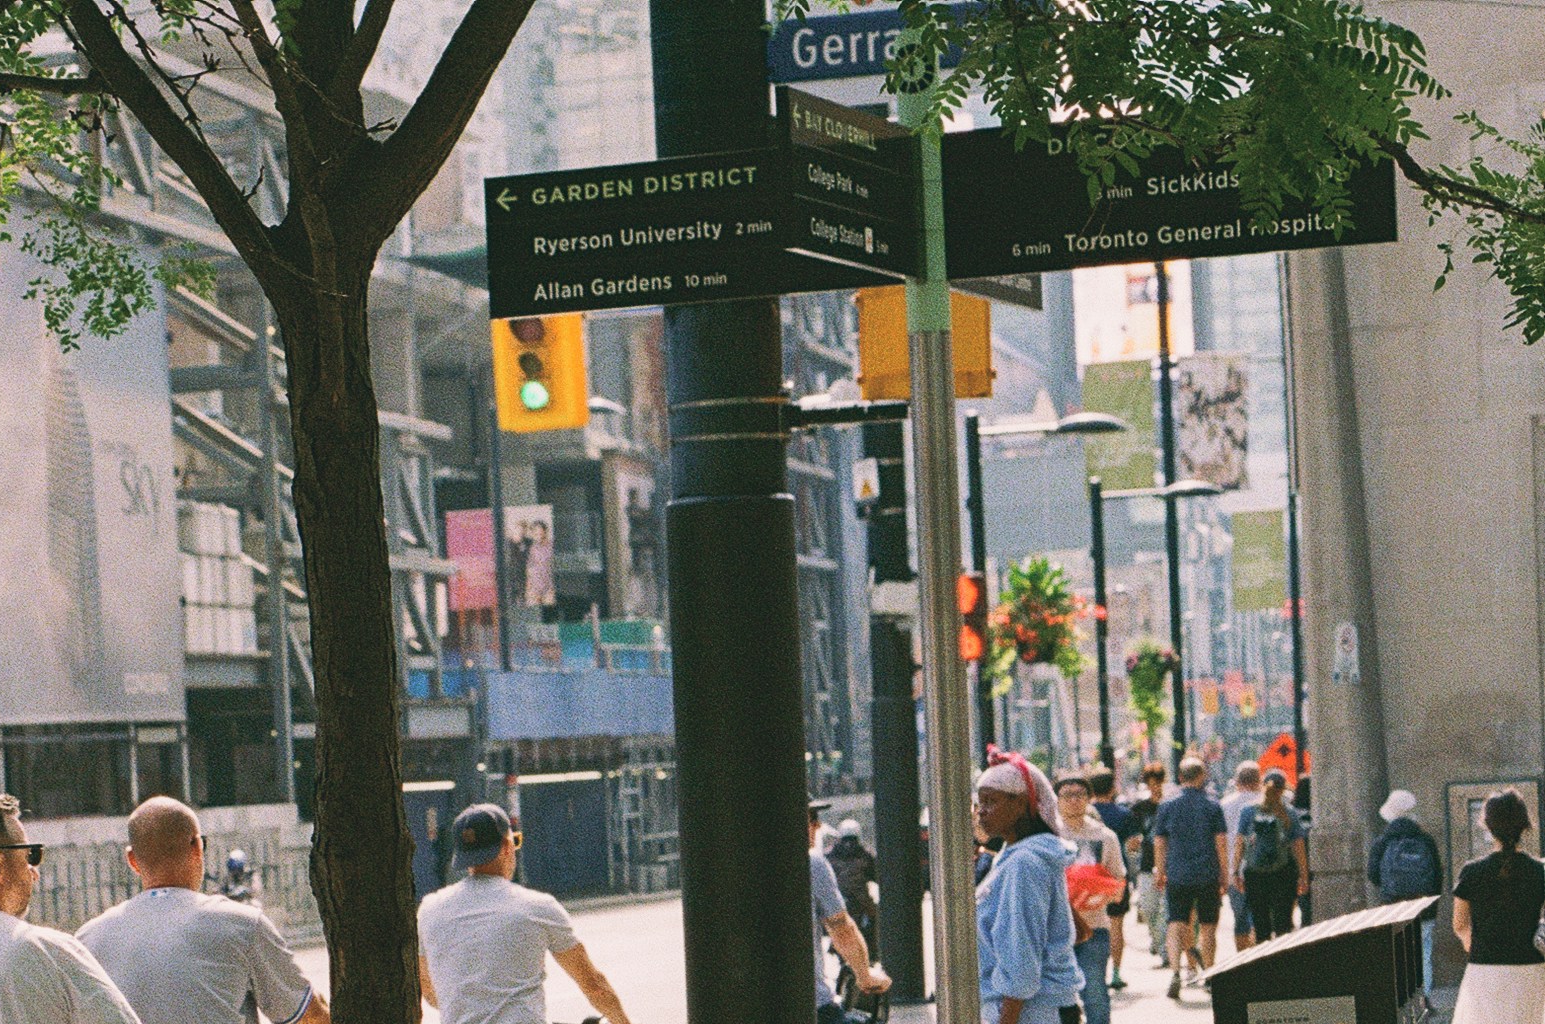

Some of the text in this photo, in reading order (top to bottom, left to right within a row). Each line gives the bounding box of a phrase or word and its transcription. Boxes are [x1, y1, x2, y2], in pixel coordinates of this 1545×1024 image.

[792, 28, 900, 68] Gerra
[531, 166, 757, 206] GARDEN DISTRICT
[1107, 185, 1133, 199] min
[1147, 169, 1240, 195] SickKids
[533, 219, 773, 256] Ryerson University 2 min
[1012, 212, 1341, 257] 6 min Toronto General ospit
[533, 272, 728, 301] Allan Gardens 10 min
